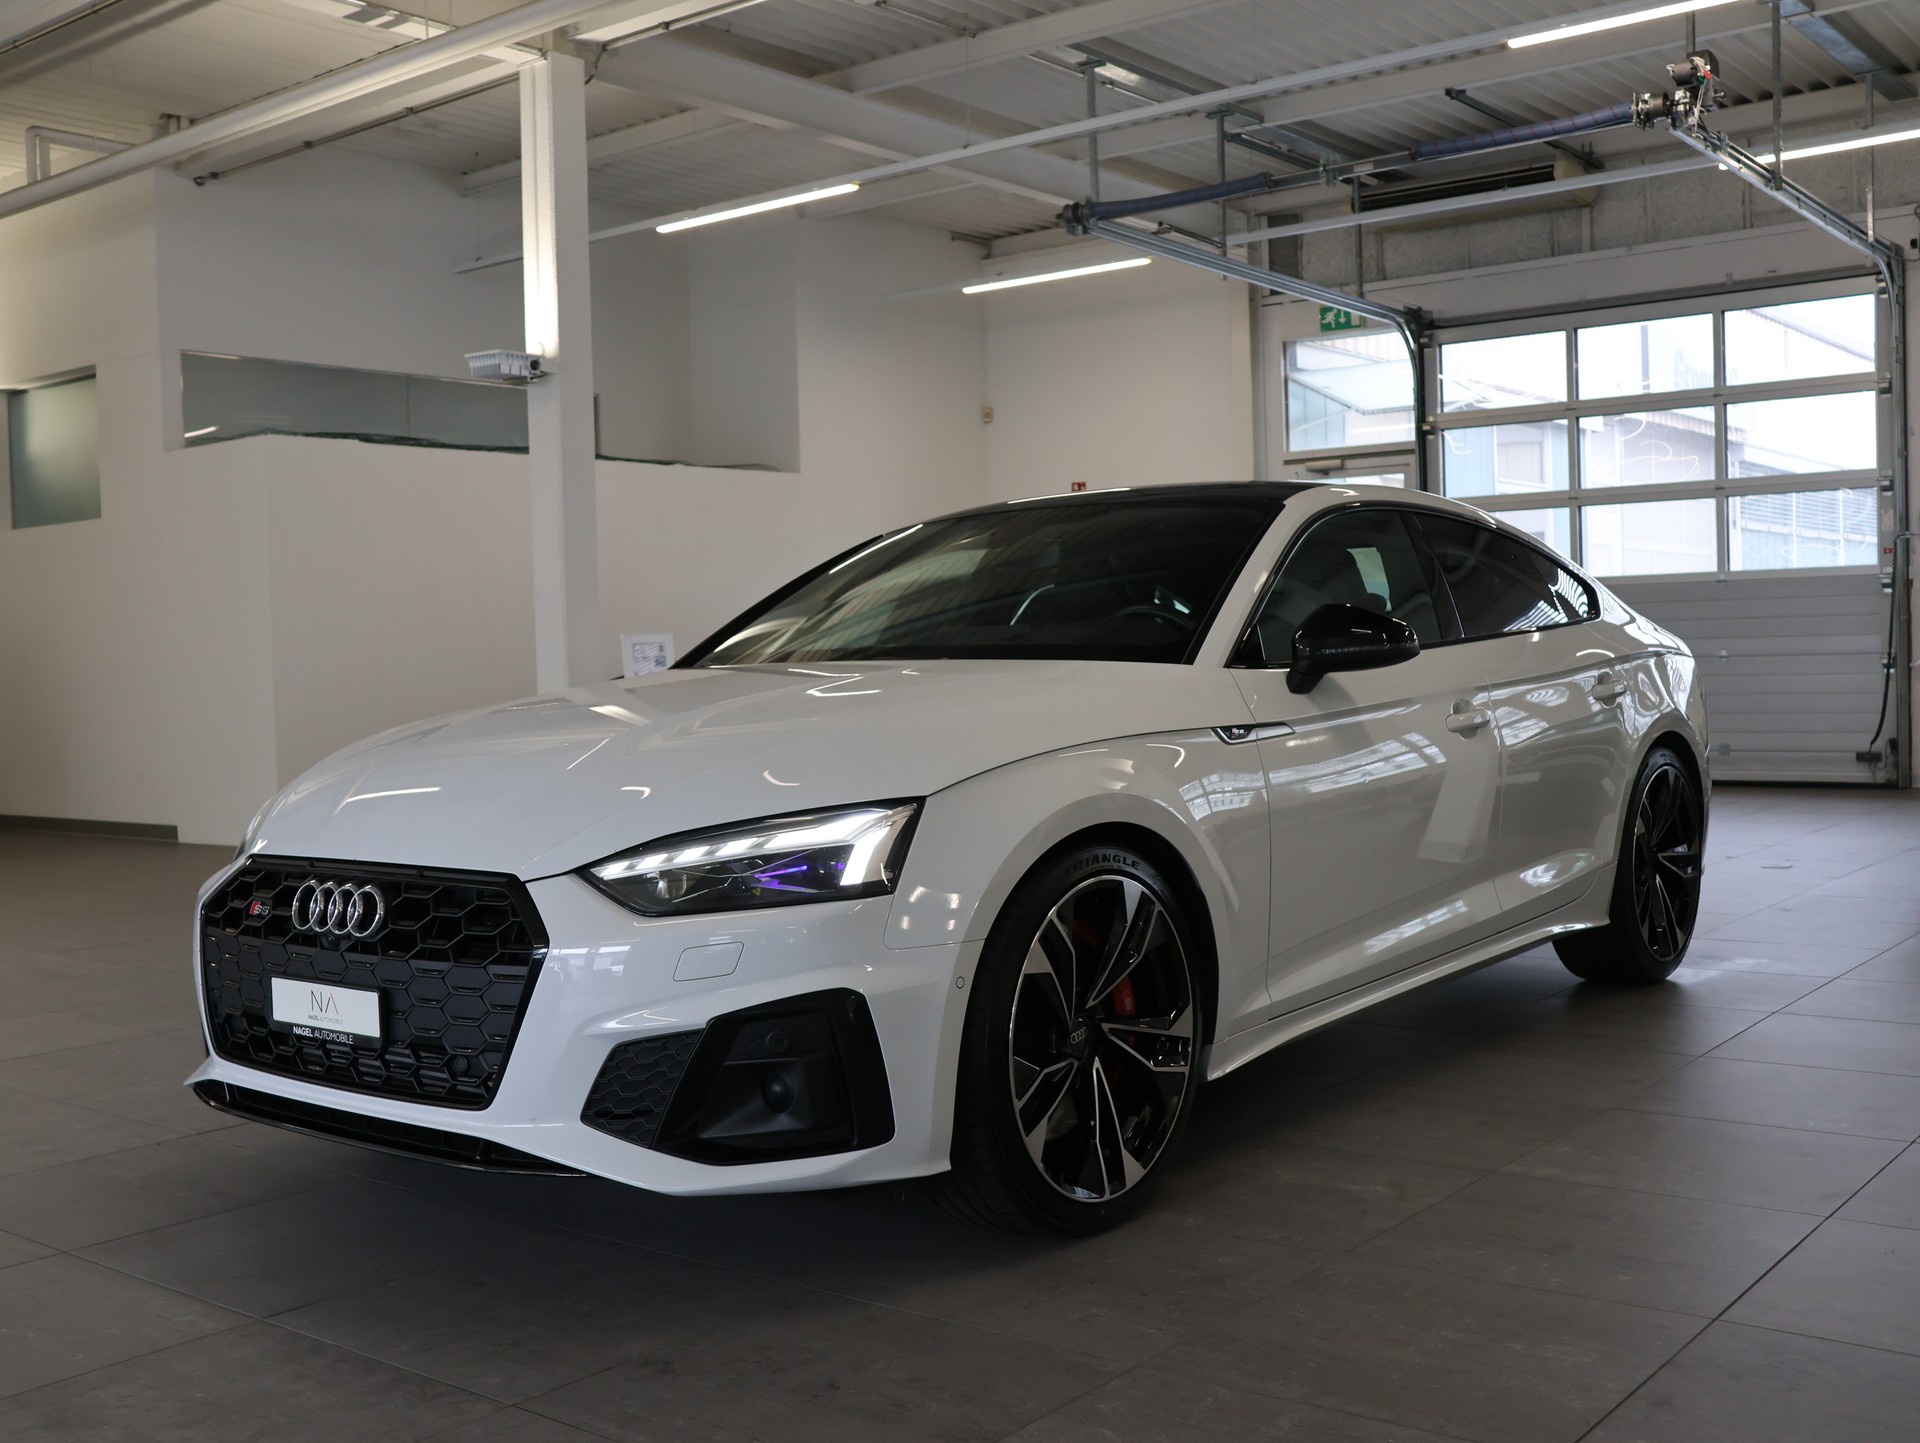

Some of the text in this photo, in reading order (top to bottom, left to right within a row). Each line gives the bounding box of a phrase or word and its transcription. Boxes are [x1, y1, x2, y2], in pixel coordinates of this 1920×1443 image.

[1063, 853, 1140, 874] TRIANGLE
[251, 902, 269, 915] S5
[293, 1026, 354, 1044] NAGEL AUTOMOBILE
